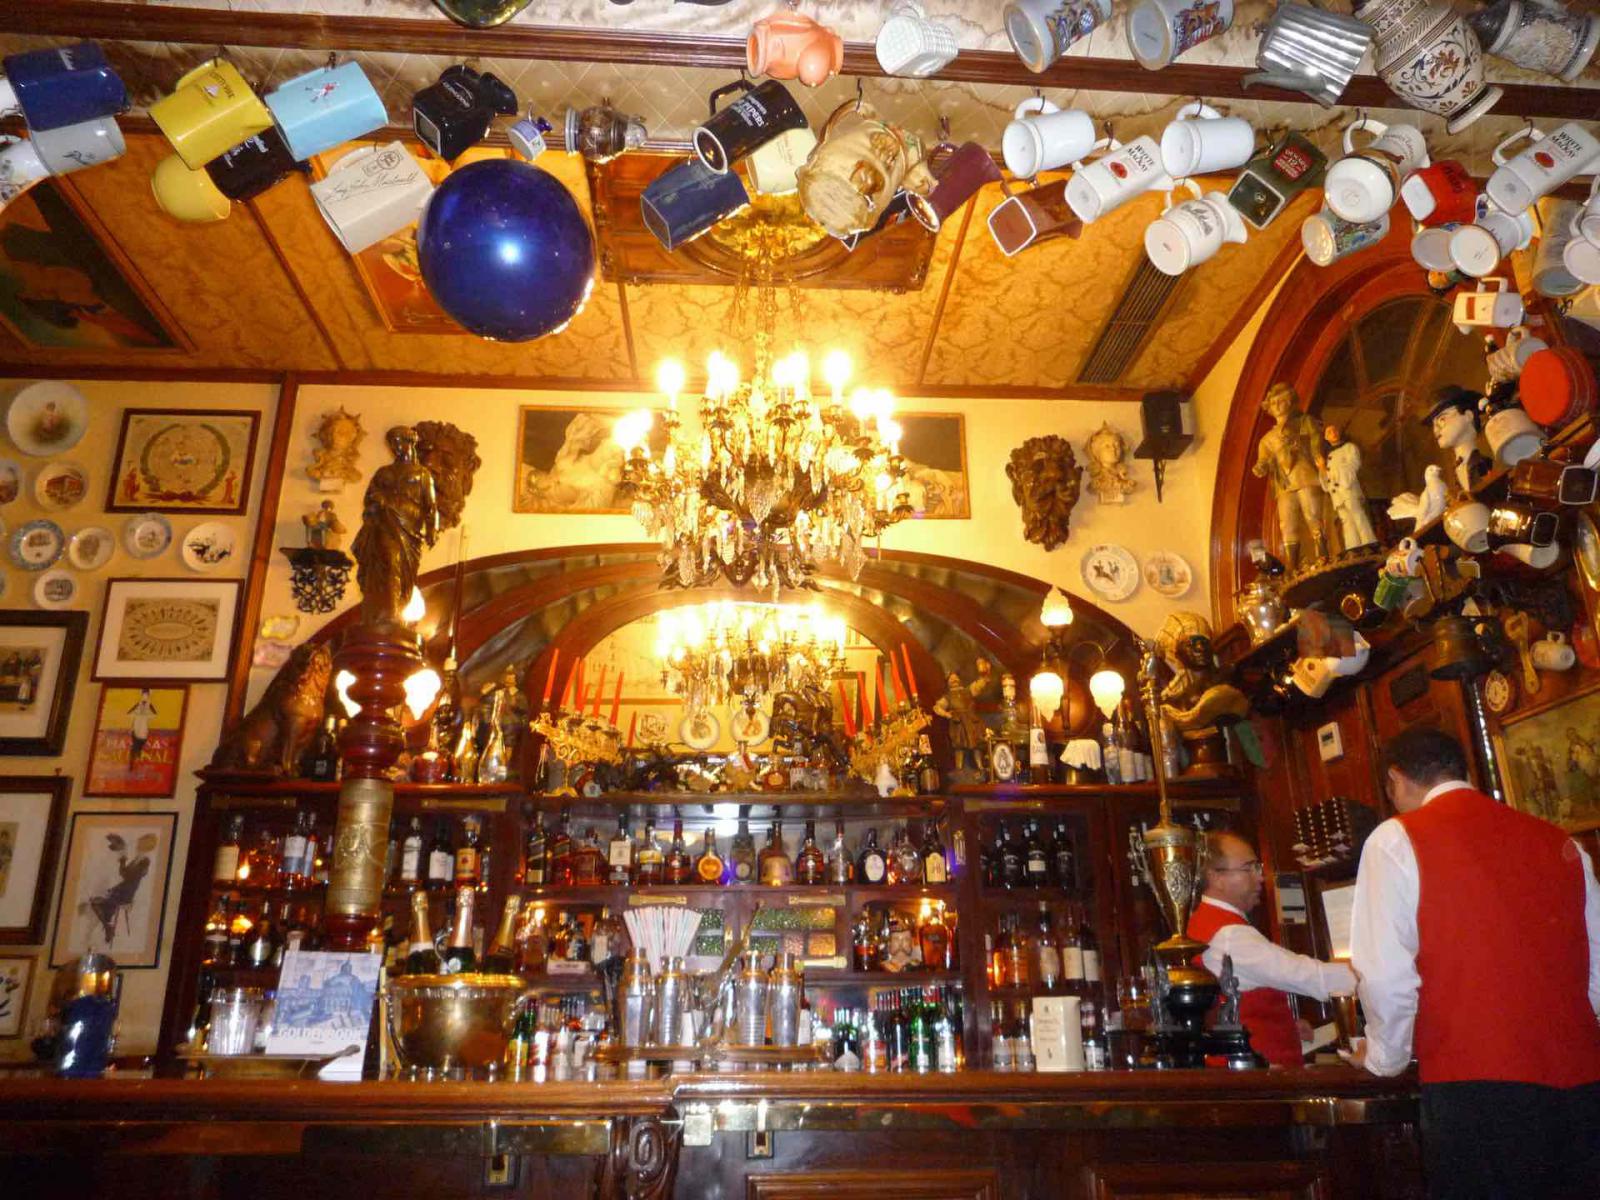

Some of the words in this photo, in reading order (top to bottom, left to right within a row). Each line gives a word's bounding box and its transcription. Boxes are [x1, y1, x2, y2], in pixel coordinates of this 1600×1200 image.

[742, 101, 766, 126] PIPERS
[1551, 135, 1576, 158] MACKAY
[1559, 131, 1583, 152] WHYTE
[1127, 147, 1149, 172] MACKAY
[1134, 144, 1154, 166] WHYTE
